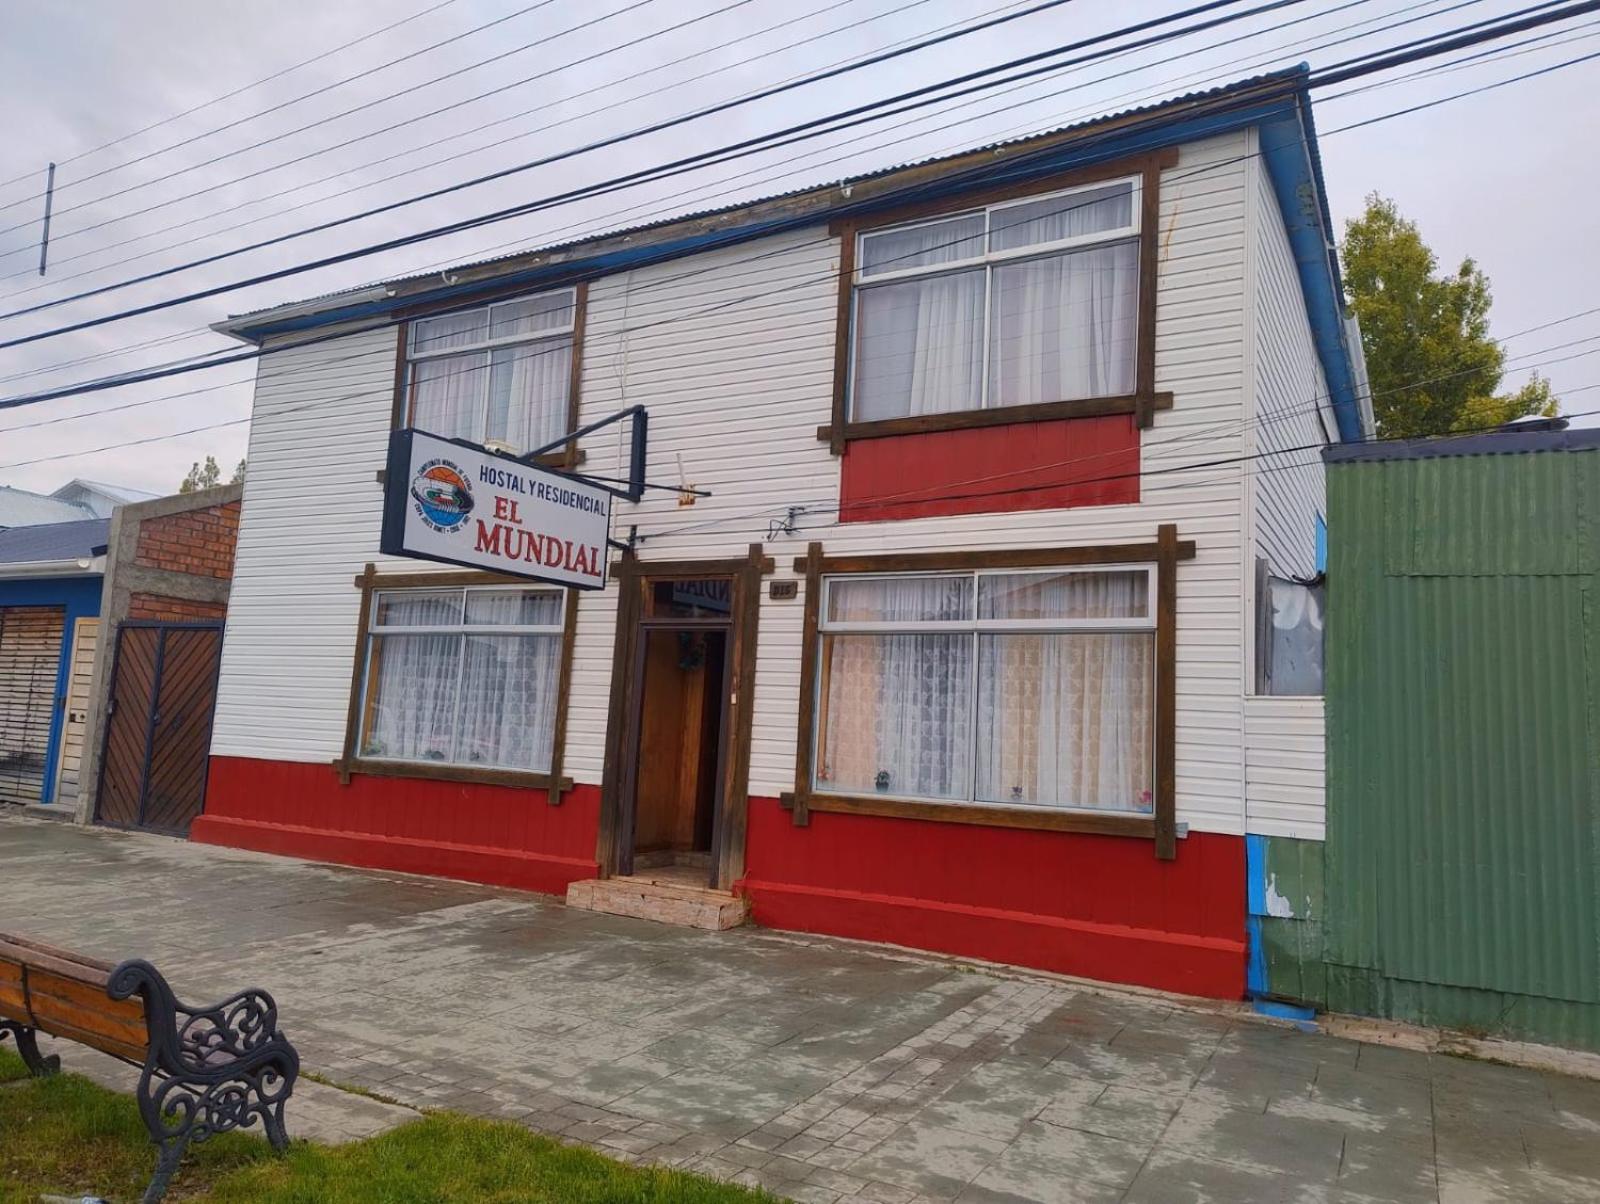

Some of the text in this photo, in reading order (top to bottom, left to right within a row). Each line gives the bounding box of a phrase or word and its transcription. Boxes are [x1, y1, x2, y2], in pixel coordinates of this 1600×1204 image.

[480, 464, 526, 494] HOSTAL
[528, 480, 537, 496] Y
[537, 482, 607, 517] RESIDENCIAL
[493, 495, 523, 524] EL
[474, 518, 602, 578] MUNDIAL
